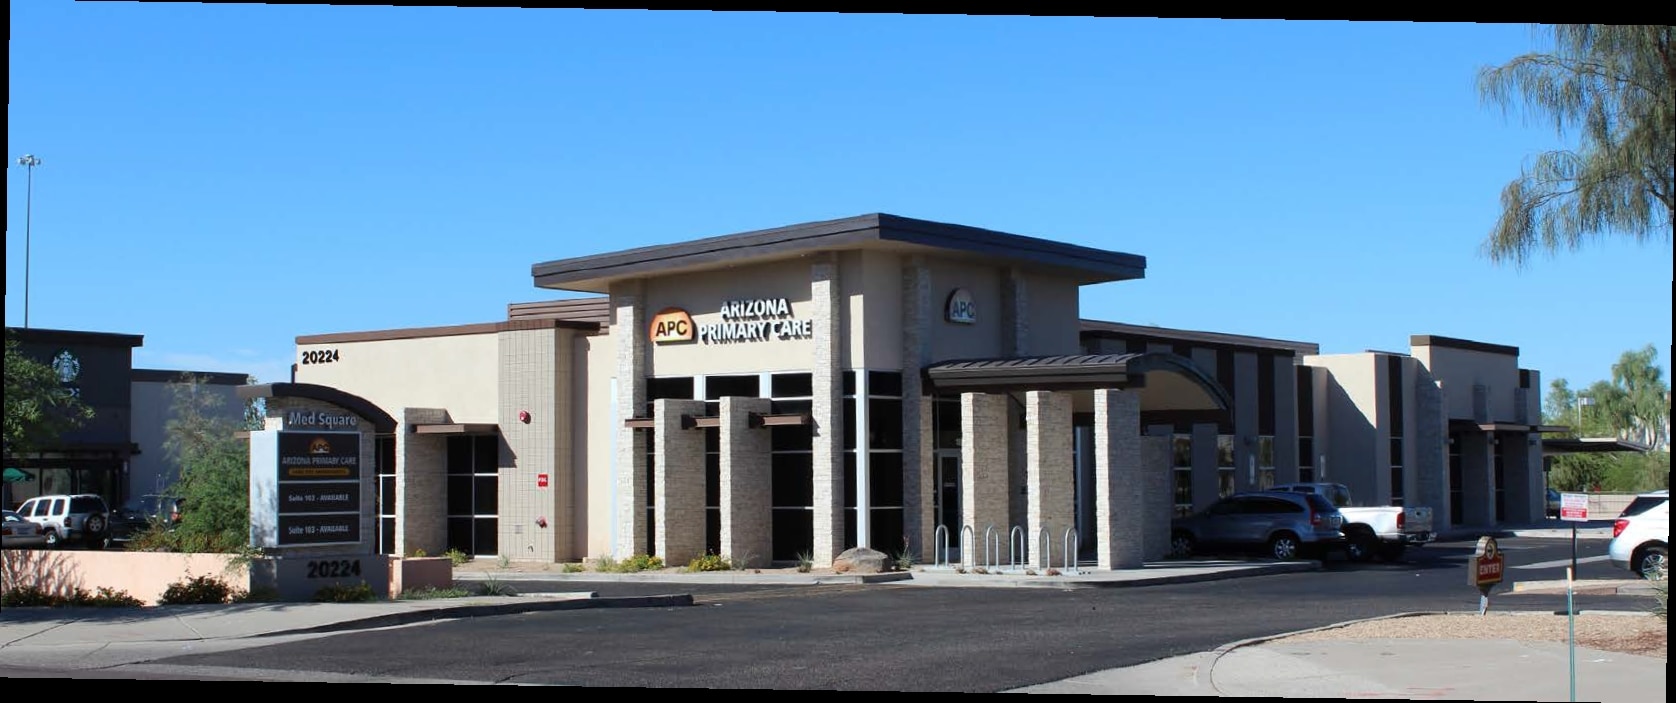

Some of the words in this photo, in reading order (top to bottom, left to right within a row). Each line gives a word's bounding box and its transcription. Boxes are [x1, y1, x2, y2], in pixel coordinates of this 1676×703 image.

[720, 298, 790, 319] ARIZONA
[951, 300, 976, 318] APC
[655, 320, 688, 337] APC
[700, 321, 767, 342] PRIMARY
[770, 320, 812, 337] CARE
[302, 349, 340, 365] 20224
[289, 412, 315, 426] Med
[318, 413, 357, 429] Square
[281, 456, 311, 465] ARIZONA
[312, 456, 339, 465] PRIMARY
[340, 456, 357, 465] CARE
[288, 494, 303, 502] Suite
[288, 526, 304, 534] Suite
[305, 526, 315, 534] 103
[320, 525, 349, 533] AVAILABLE
[307, 560, 362, 579] 20224
[1480, 562, 1500, 575] ENTER
